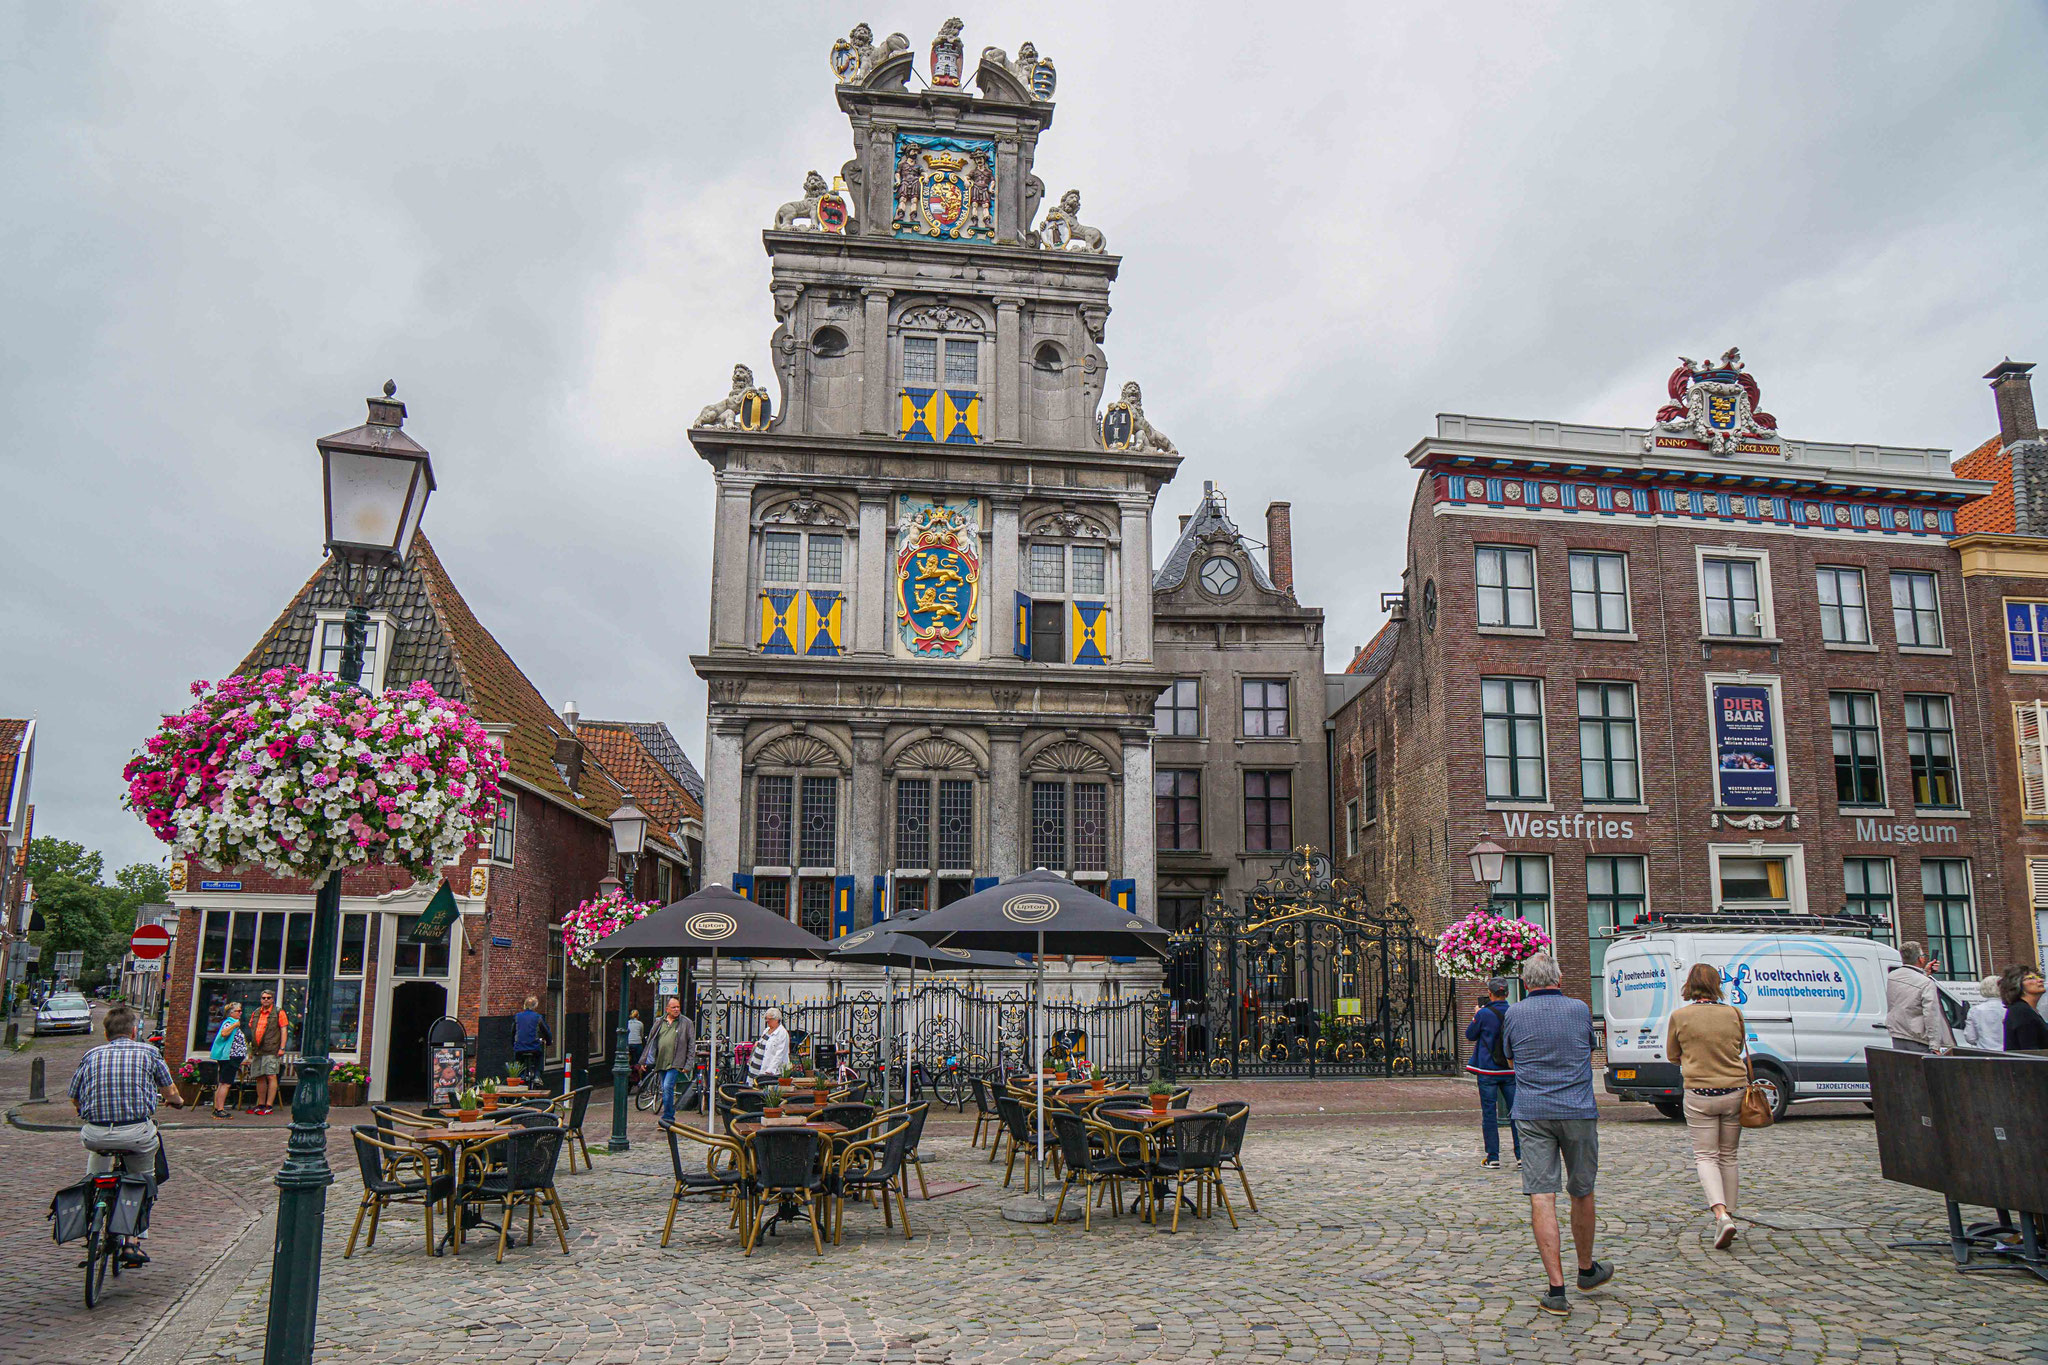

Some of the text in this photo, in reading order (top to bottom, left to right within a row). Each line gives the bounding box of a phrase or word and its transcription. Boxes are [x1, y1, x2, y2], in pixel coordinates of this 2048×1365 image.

[1657, 438, 1687, 448] ANNO
[1723, 698, 1764, 710] DIER
[1724, 710, 1765, 722] BAAR
[1502, 812, 1958, 843] Westfries Museum
[1624, 969, 1665, 981] koeltechniek &
[1754, 969, 1843, 982] koeltechniek &
[1757, 985, 1846, 1000] klimaatbeheersing
